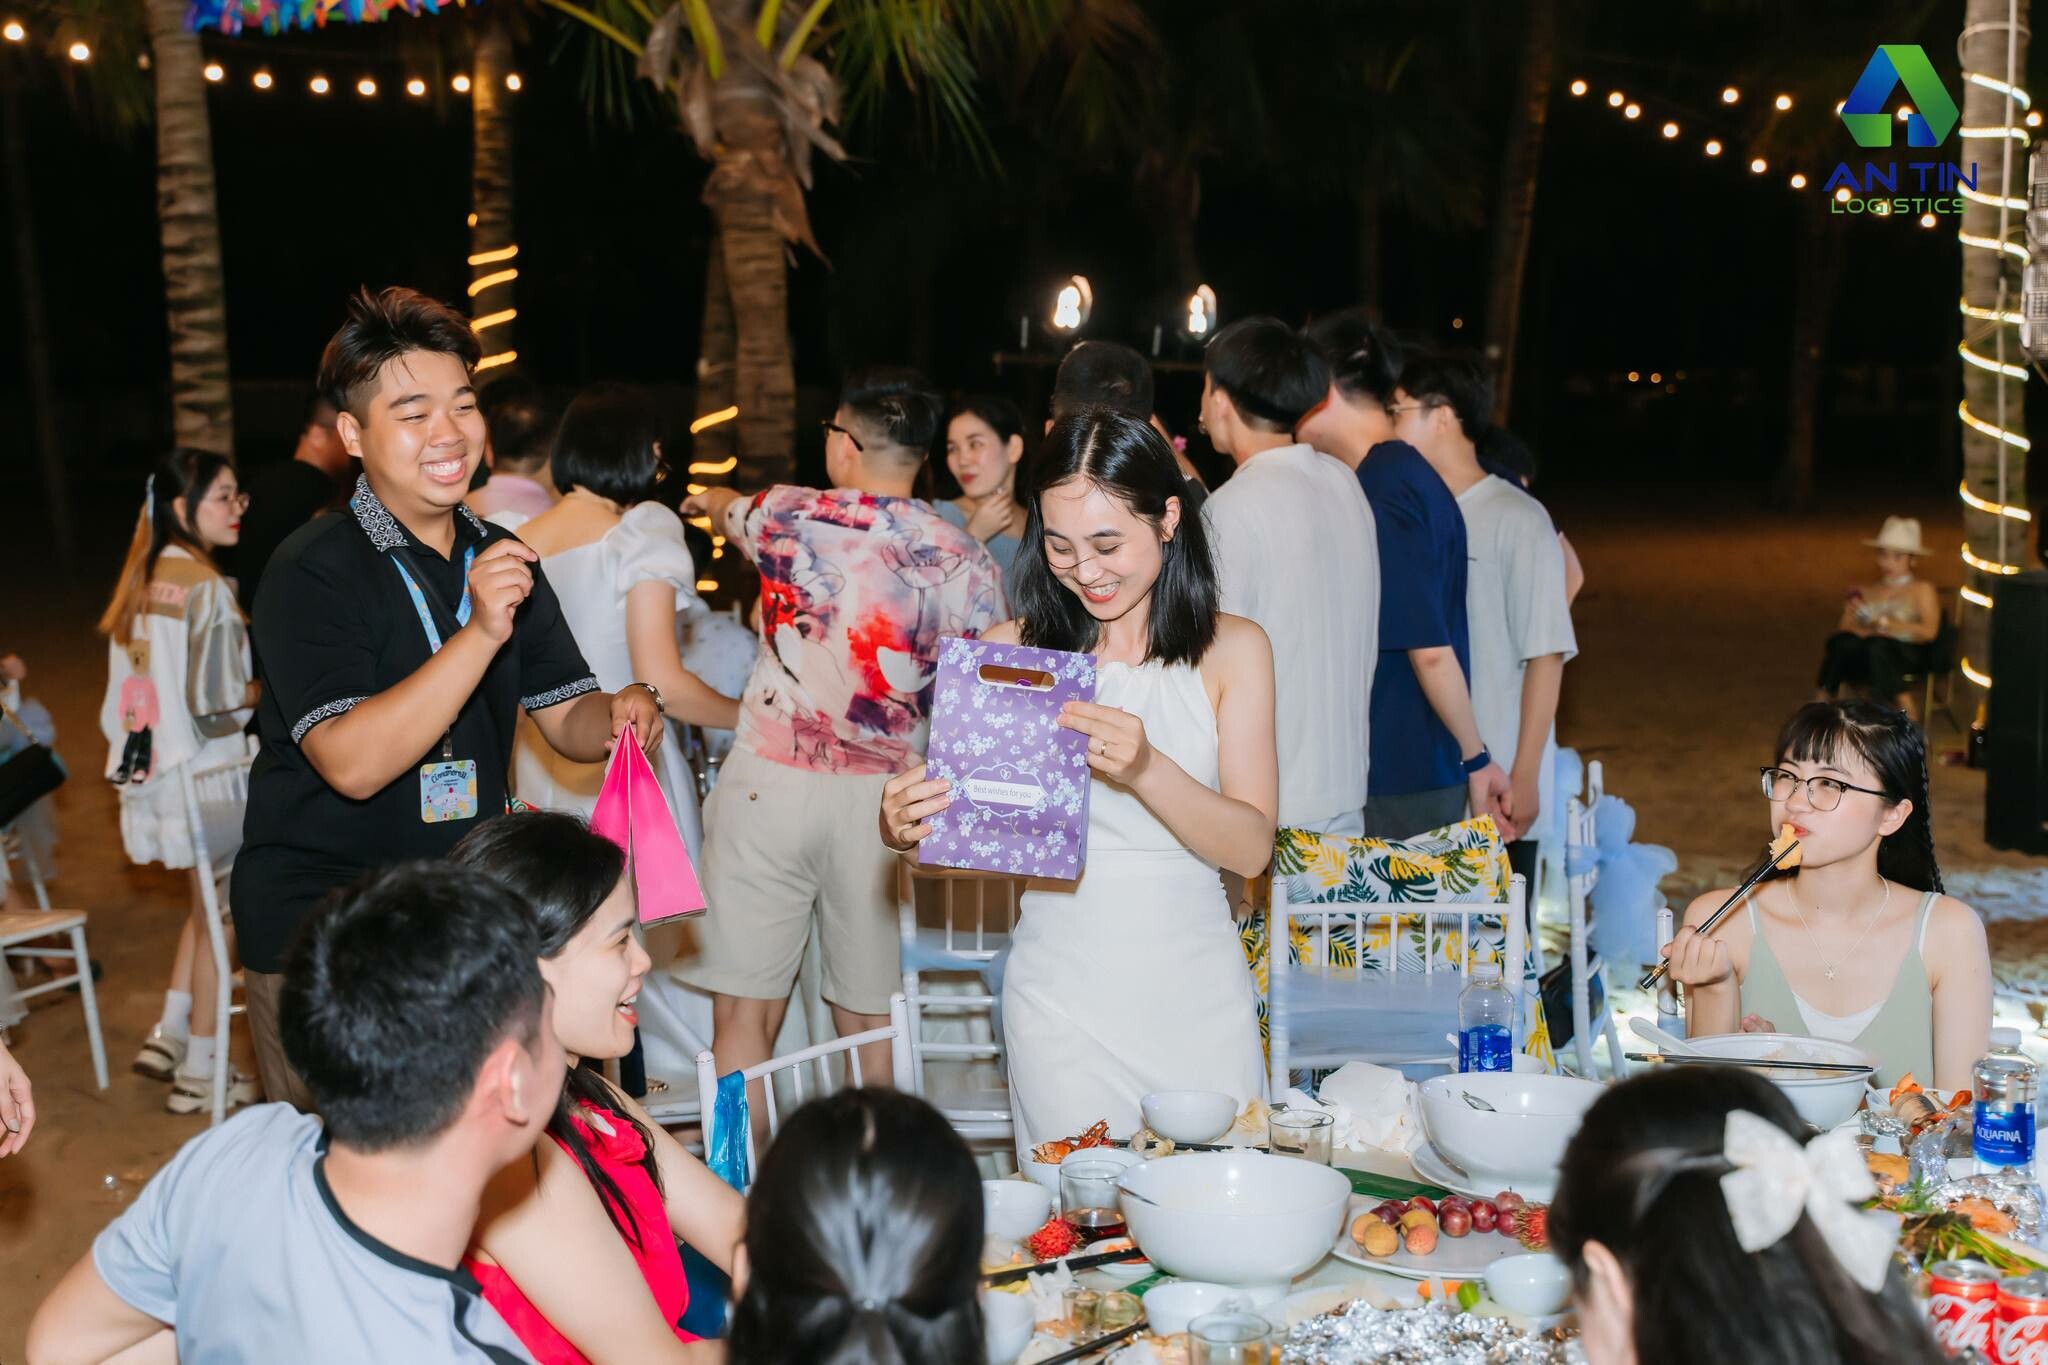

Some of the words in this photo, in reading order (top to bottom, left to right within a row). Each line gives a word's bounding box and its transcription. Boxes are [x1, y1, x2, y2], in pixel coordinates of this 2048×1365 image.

[973, 784, 987, 794] Best
[988, 786, 1009, 796] wishes
[1009, 788, 1019, 797] for
[1019, 791, 1031, 800] you
[1976, 1125, 2022, 1143] AQUAFINA
